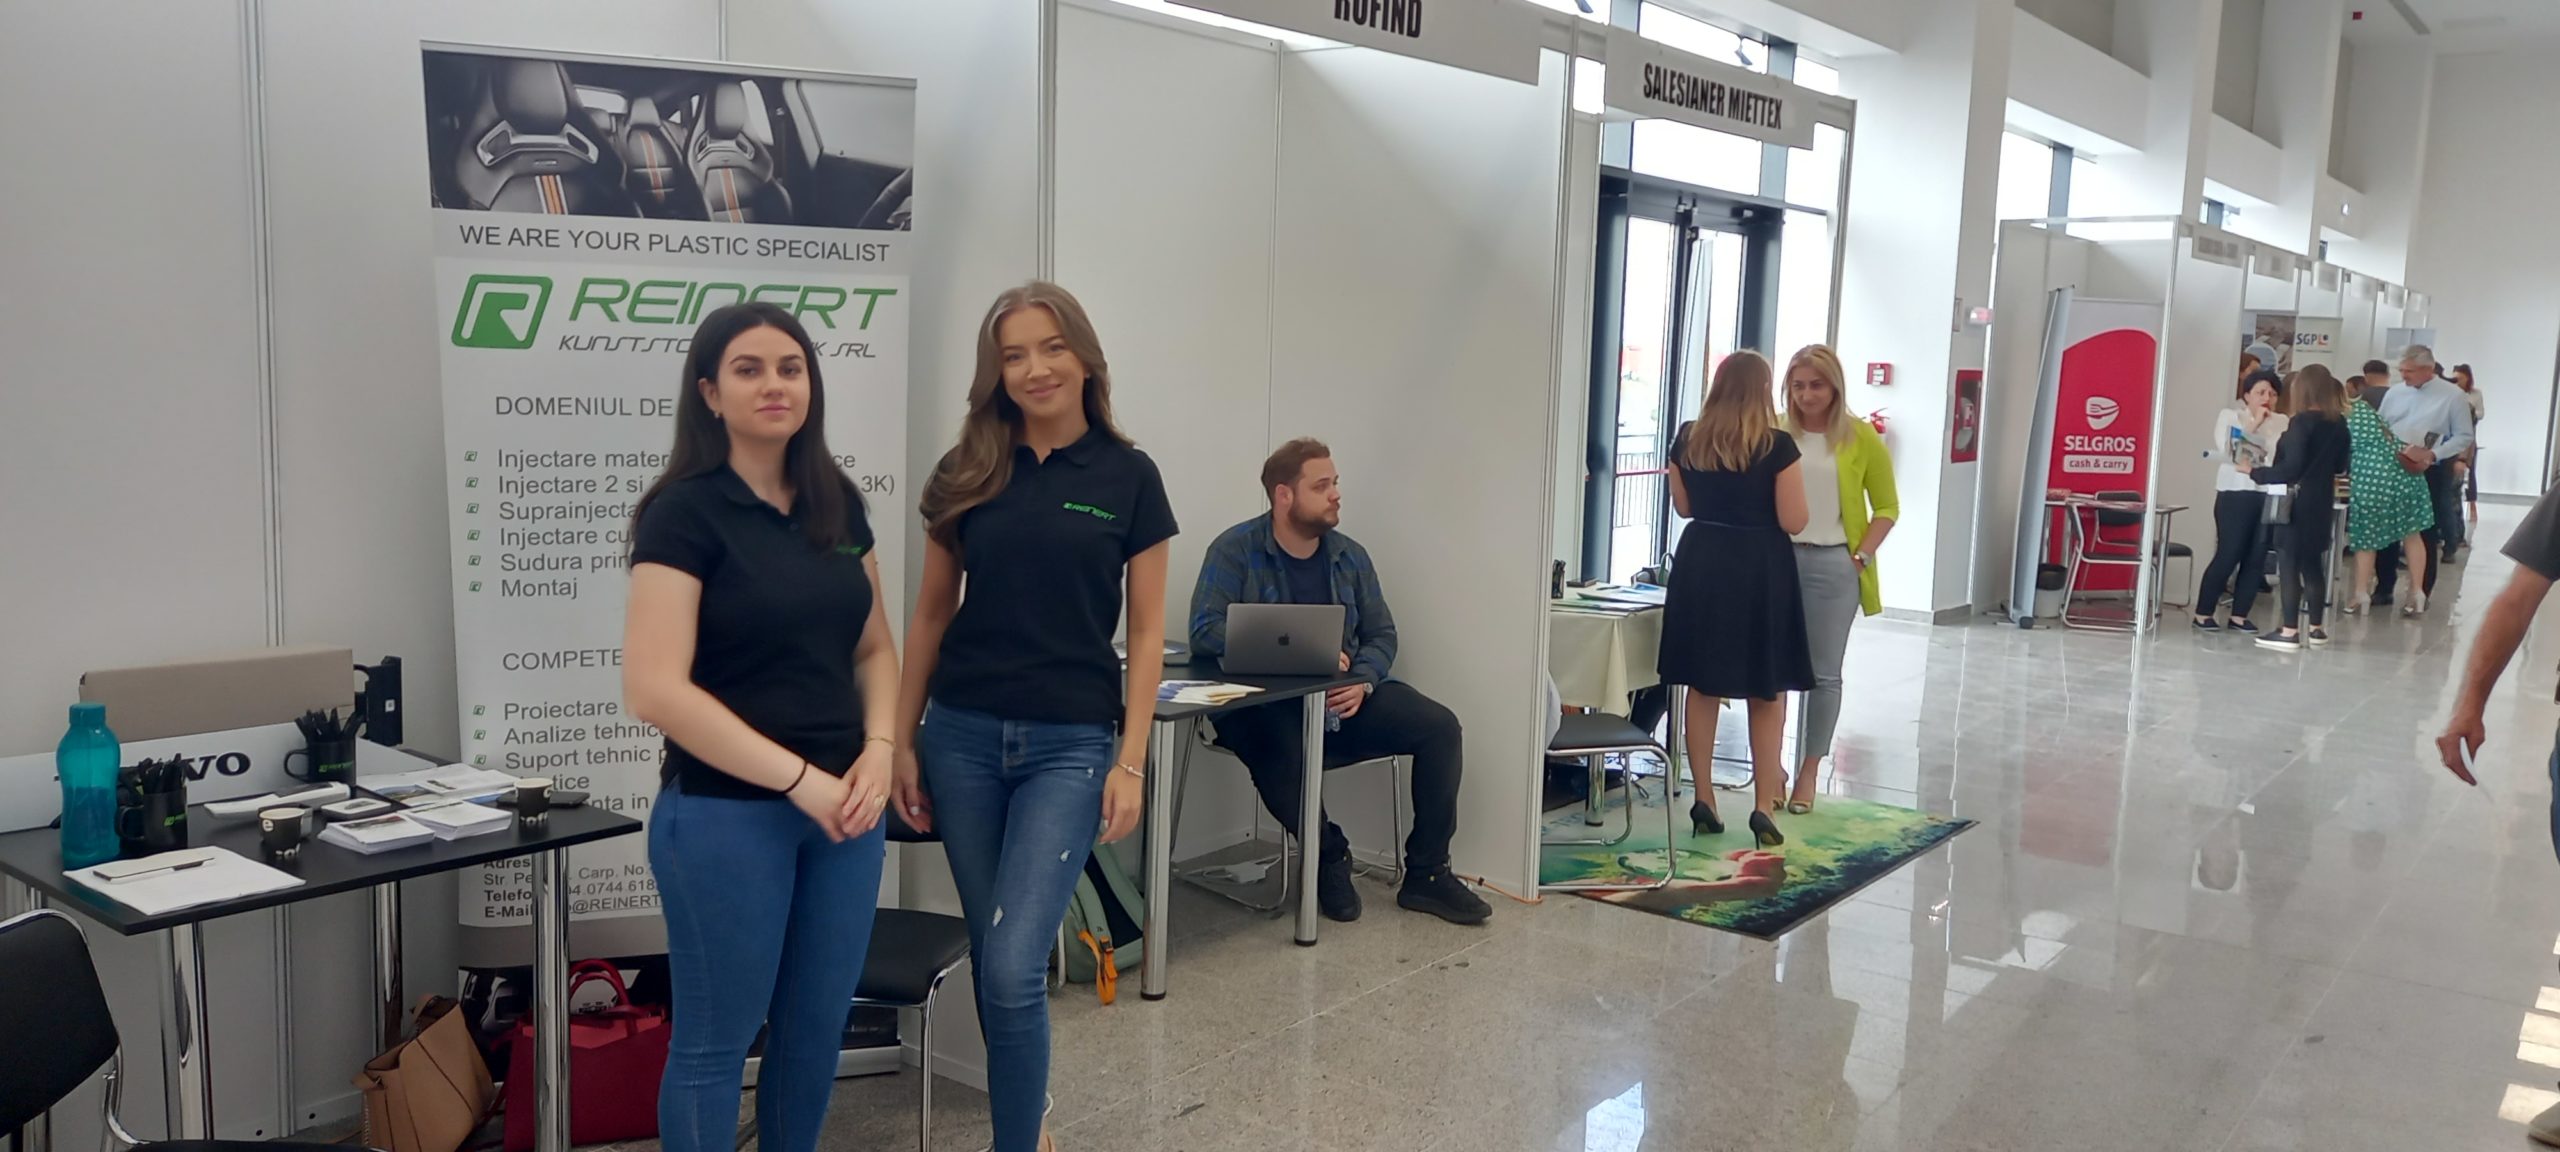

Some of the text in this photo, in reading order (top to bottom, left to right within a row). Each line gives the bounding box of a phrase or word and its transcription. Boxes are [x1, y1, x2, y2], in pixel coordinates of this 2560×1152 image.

[1643, 63, 1783, 130] SALESIANER MIETTEX
[459, 225, 890, 262] WE ARE YOUR PLASTIC SPECIALIST
[569, 277, 898, 330] REINERT
[830, 343, 876, 358] SRL
[495, 396, 673, 417] DOMENIUL DE
[2063, 435, 2136, 453] SELGROS
[498, 449, 856, 472] Injectare mater ce
[2069, 458, 2128, 471] cash & carry
[499, 475, 597, 499] Injectare
[605, 475, 618, 493] 2
[626, 476, 643, 493] si
[861, 474, 895, 496] 3K)
[499, 501, 638, 524] Suprainjecta
[500, 528, 597, 550] Injectare
[500, 553, 583, 572] Sudura
[501, 578, 578, 600] Montaj
[503, 648, 623, 671] COMPETE
[504, 700, 618, 721] Proiectare
[504, 726, 586, 745] Analize
[505, 751, 579, 772] Suport
[587, 745, 651, 765] tehnic
[552, 774, 590, 791] tice
[591, 793, 649, 811] nta in
[483, 857, 531, 869] Adres
[514, 872, 533, 885] Pe
[484, 889, 532, 902] Telefo
[568, 894, 661, 914] @REINERT
